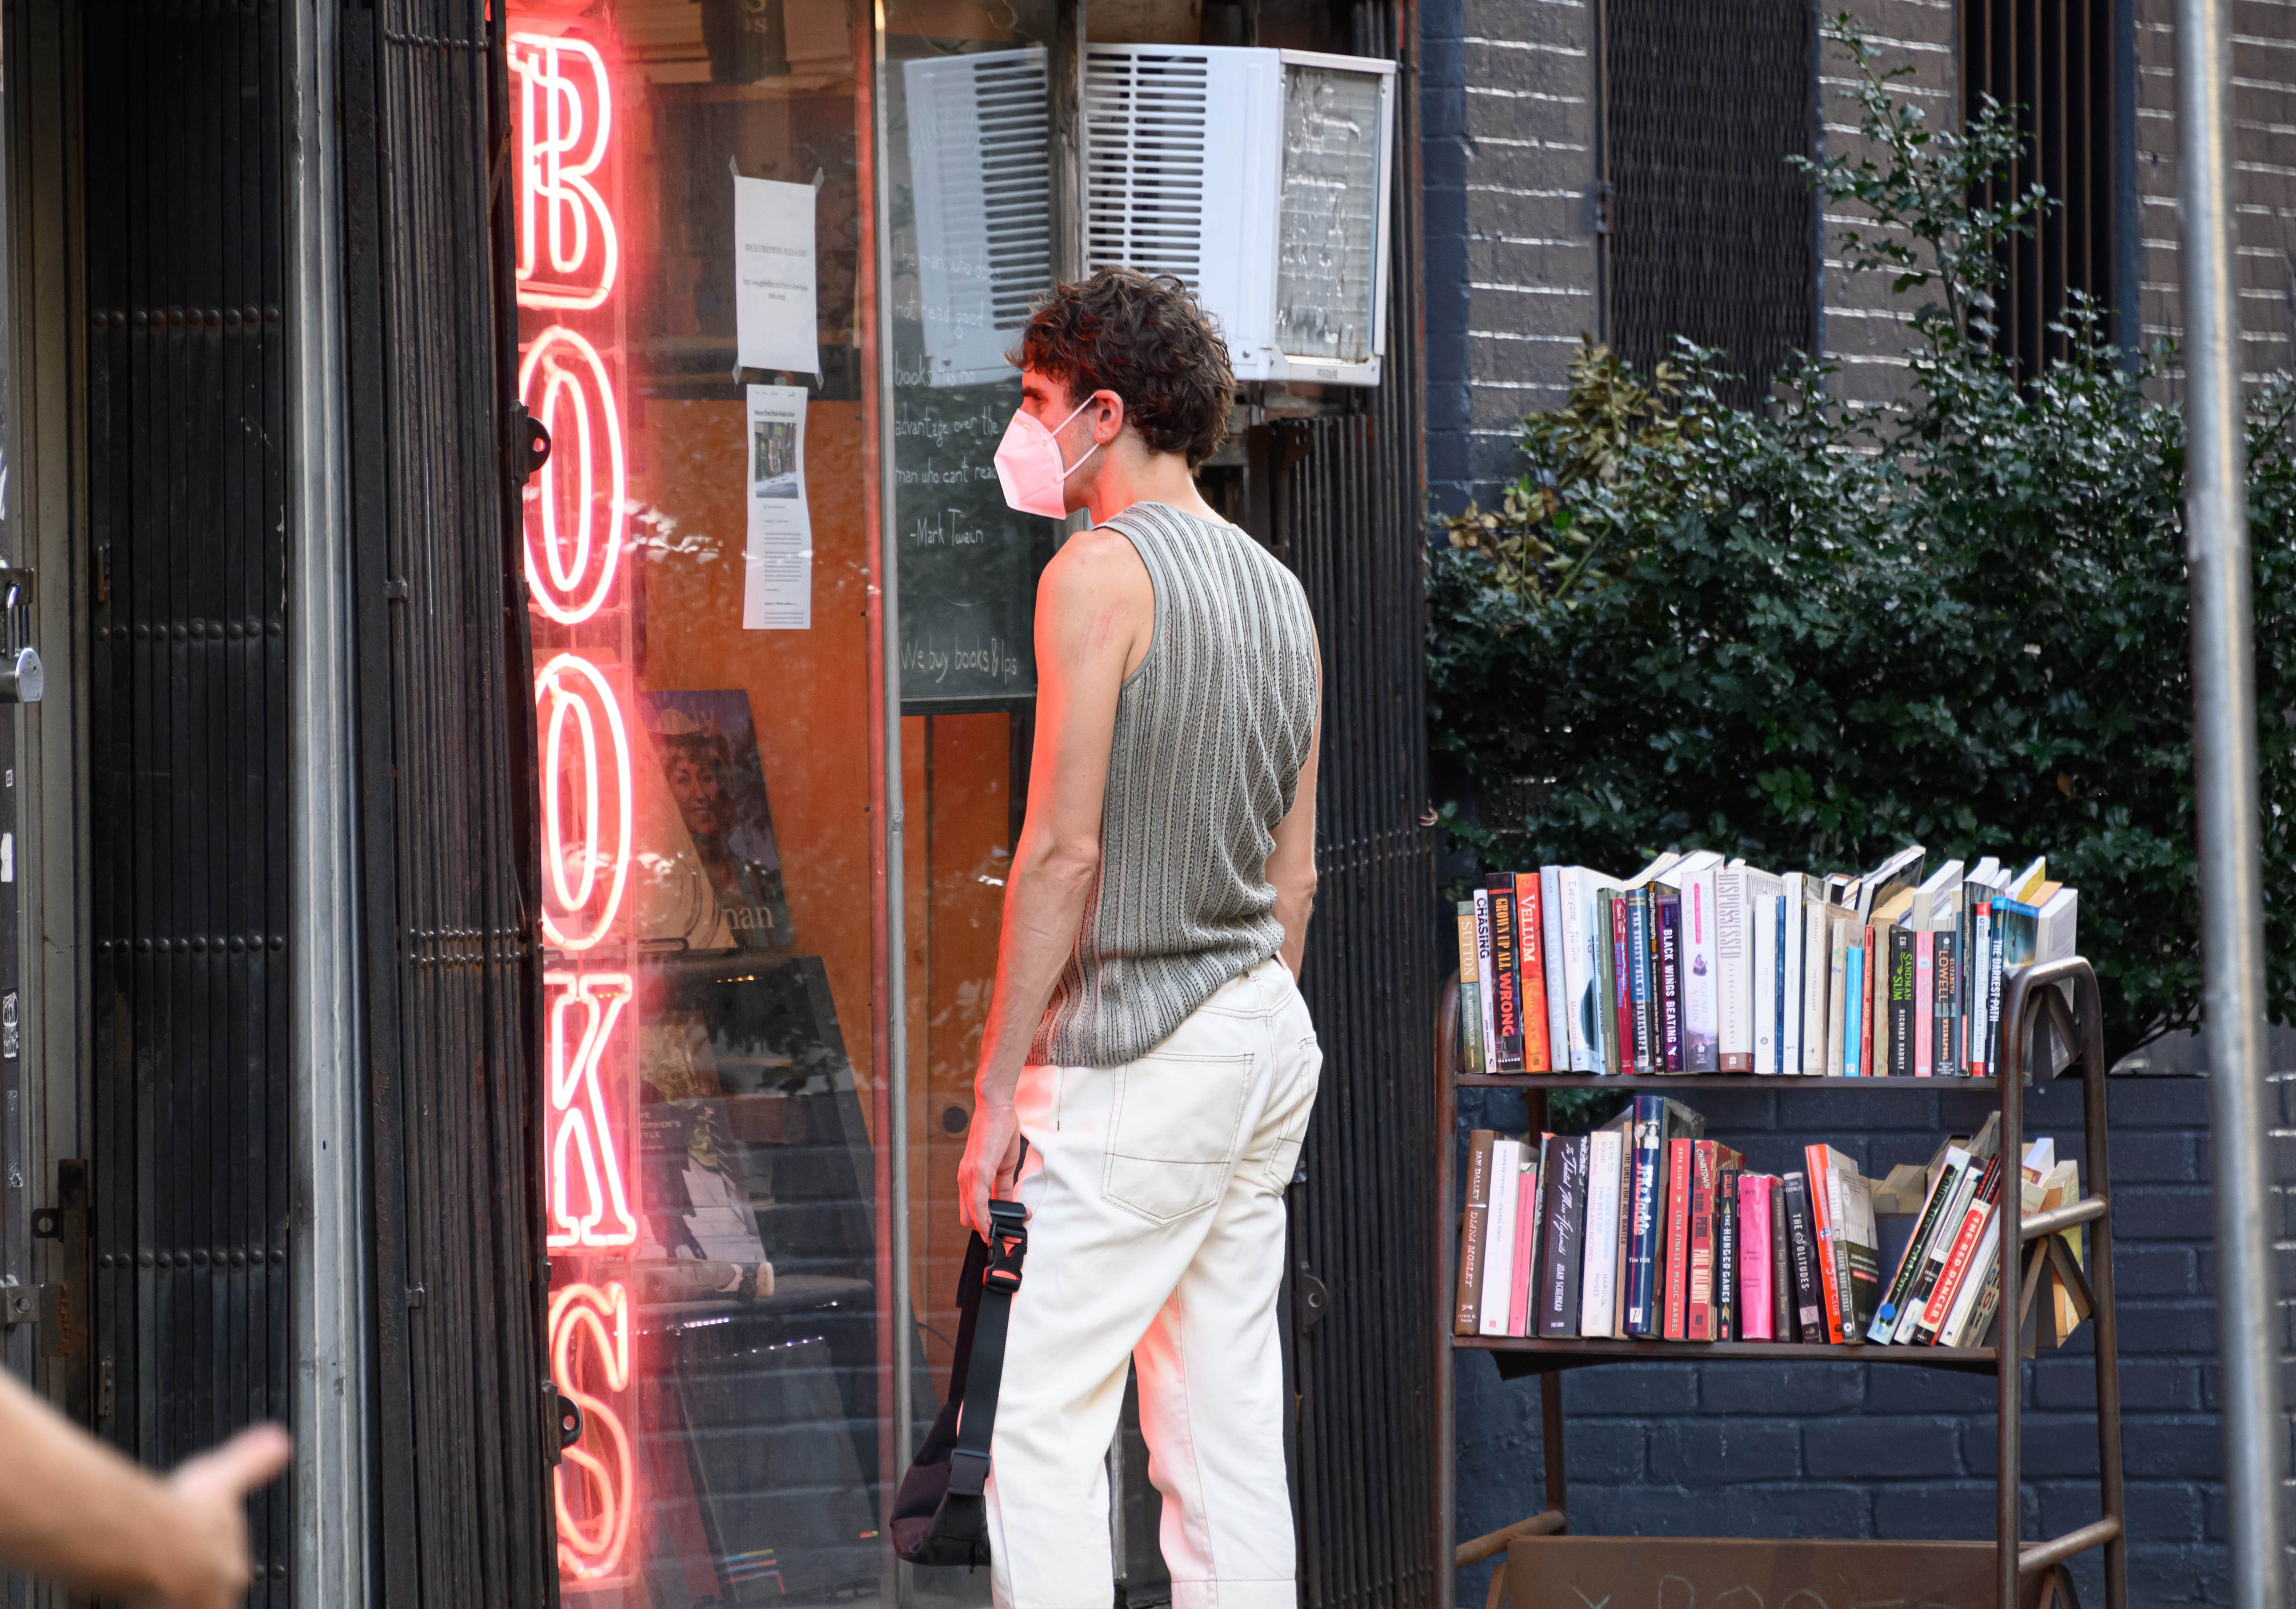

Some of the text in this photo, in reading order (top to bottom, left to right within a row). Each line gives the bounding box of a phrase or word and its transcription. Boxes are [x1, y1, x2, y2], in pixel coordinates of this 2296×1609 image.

[955, 298, 983, 339] good
[895, 351, 933, 387] books
[895, 403, 998, 448] advantage over the
[895, 456, 939, 484] man who
[948, 508, 983, 546] Twain
[899, 635, 998, 684] We buy books &
[507, 31, 639, 1582] BOOKS
[1568, 881, 1576, 921] Everyone
[1718, 873, 1741, 959] DISPOSSESSED
[1461, 921, 1475, 976] SUTTON
[1476, 897, 1492, 997] CHASING COOL
[1521, 894, 1536, 964] VELLUM
[1571, 932, 1579, 944] No
[1992, 940, 2003, 956] THE
[1496, 898, 1514, 1037] GROWN UP ALL WRONG
[1547, 919, 1562, 1027] GREAT OCEAN
[1633, 911, 1647, 1051] THE GUADELOUPE
[1663, 928, 1676, 1043] BLACK WINGS BEATING
[1903, 952, 1912, 1000] SANDMAN
[1939, 950, 1949, 1002] LOWELL
[1991, 958, 2002, 998] DARKEST
[1692, 988, 1698, 998] A.
[1701, 981, 1709, 1028] ELIZABETH
[1989, 1000, 2000, 1022] PATH
[1467, 999, 1476, 1046] MOEHRINGER
[1528, 995, 1537, 1041] DUNCAN
[1473, 1168, 1482, 1200] DALLEY
[1561, 1151, 1577, 1188] Talented
[1607, 1164, 1614, 1172] TO
[1696, 1148, 1711, 1190] CHINATOWN
[1724, 1174, 1732, 1198] COLLINS
[1558, 1185, 1573, 1213] Miss
[1694, 1193, 1708, 1240] CLOUD PERIL
[1828, 1176, 1842, 1220] CONCUSSION
[1923, 1174, 1952, 1229] Killing Time
[1553, 1213, 1574, 1256] Highsmith
[1597, 1223, 1602, 1233] OF
[1604, 1217, 1611, 1228] TO
[1465, 1211, 1478, 1288] DIANA MOSLEY
[1723, 1229, 1732, 1270] HUNGER
[1792, 1213, 1810, 1291] THE SOLITUDES
[1896, 1244, 1921, 1292] Caleb Carr
[1931, 1217, 1980, 1318] THE RED DANCER
[1554, 1263, 1565, 1312] JOAN SCHENKAR
[1691, 1249, 1710, 1305] PAUL MALMONT
[1721, 1270, 1731, 1303] GAMES
[1777, 1262, 1786, 1294] JEFFERSON
[1826, 1247, 1840, 1317] THE CLUB
[1836, 1249, 1850, 1312] JEANNE MARIE LASKAS
